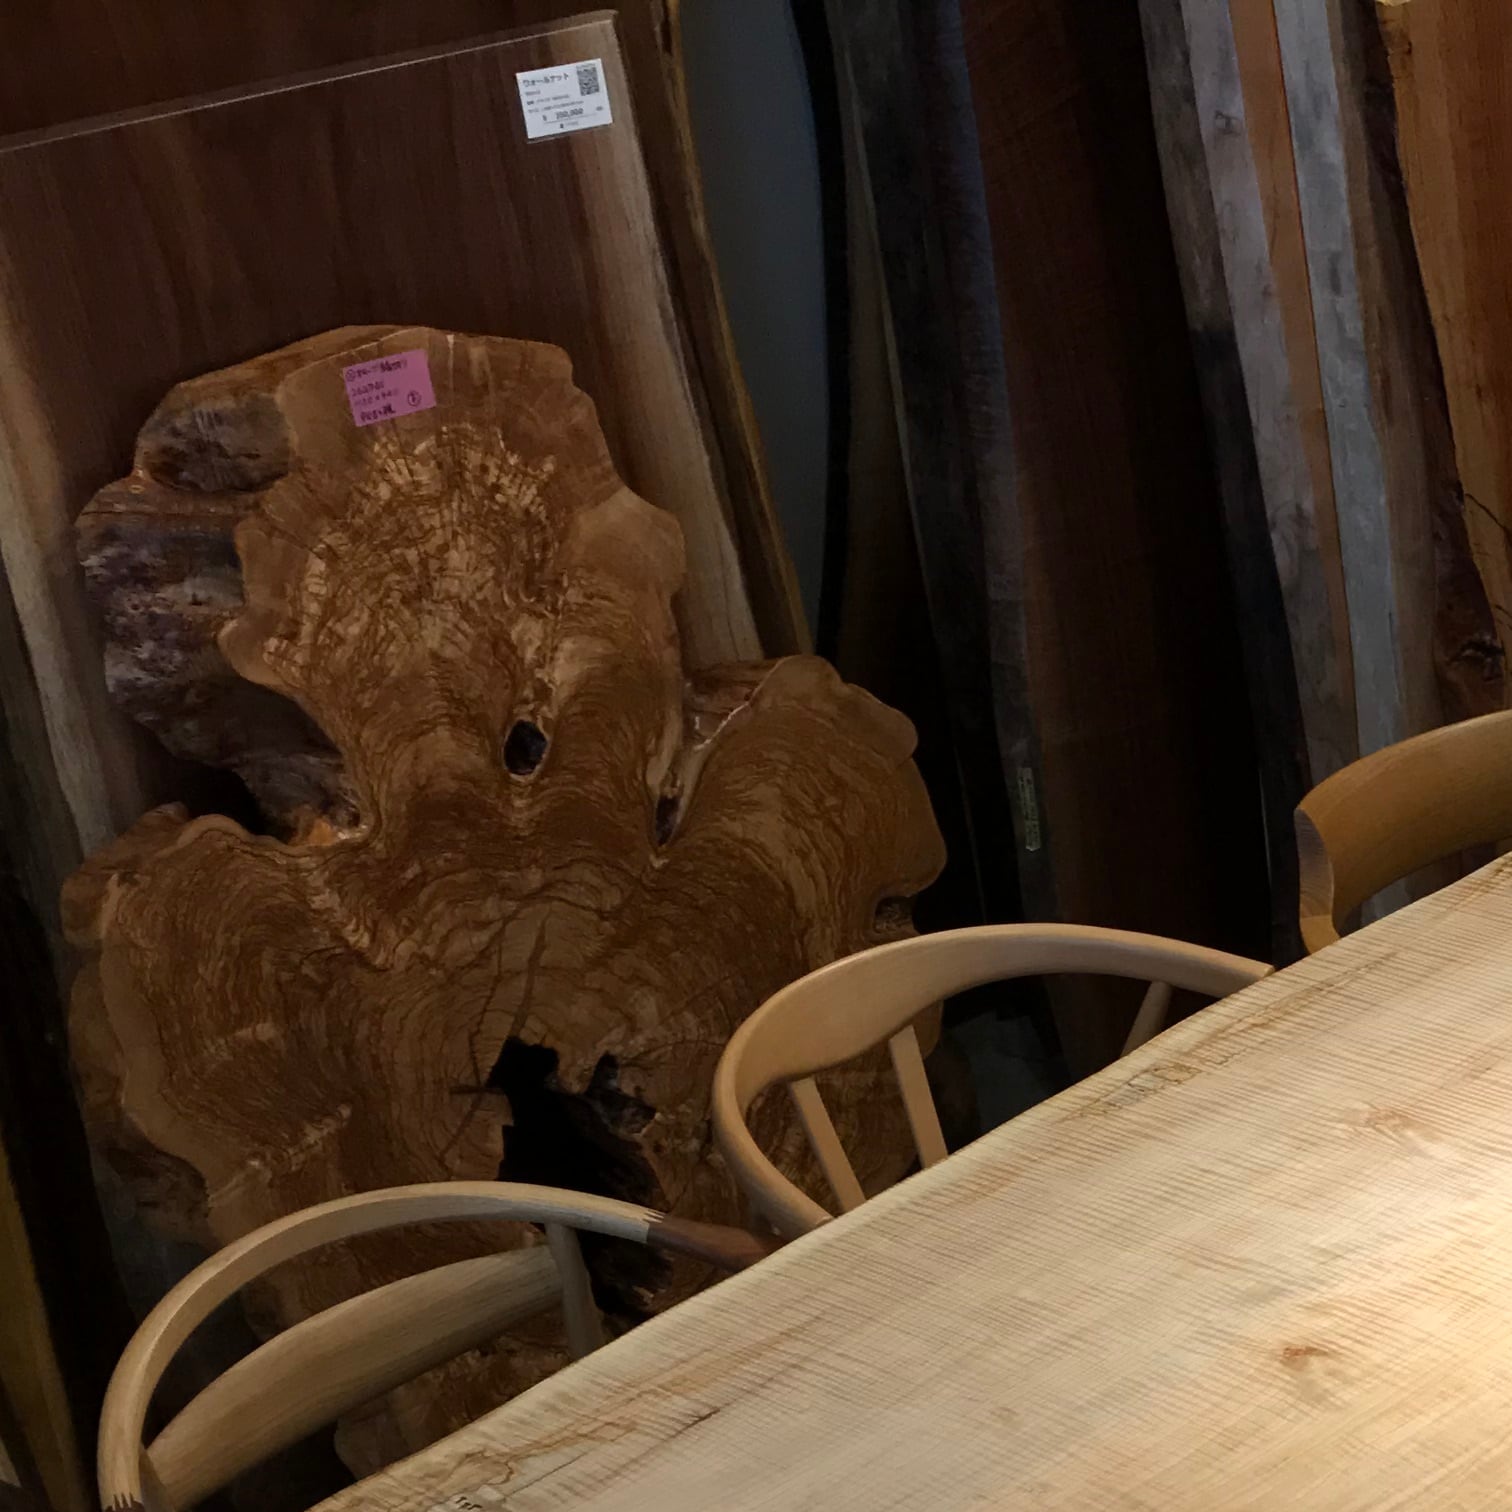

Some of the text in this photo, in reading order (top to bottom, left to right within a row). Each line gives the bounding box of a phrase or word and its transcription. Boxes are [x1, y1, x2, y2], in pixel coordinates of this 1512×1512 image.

[522, 72, 569, 88] ウォールナット
